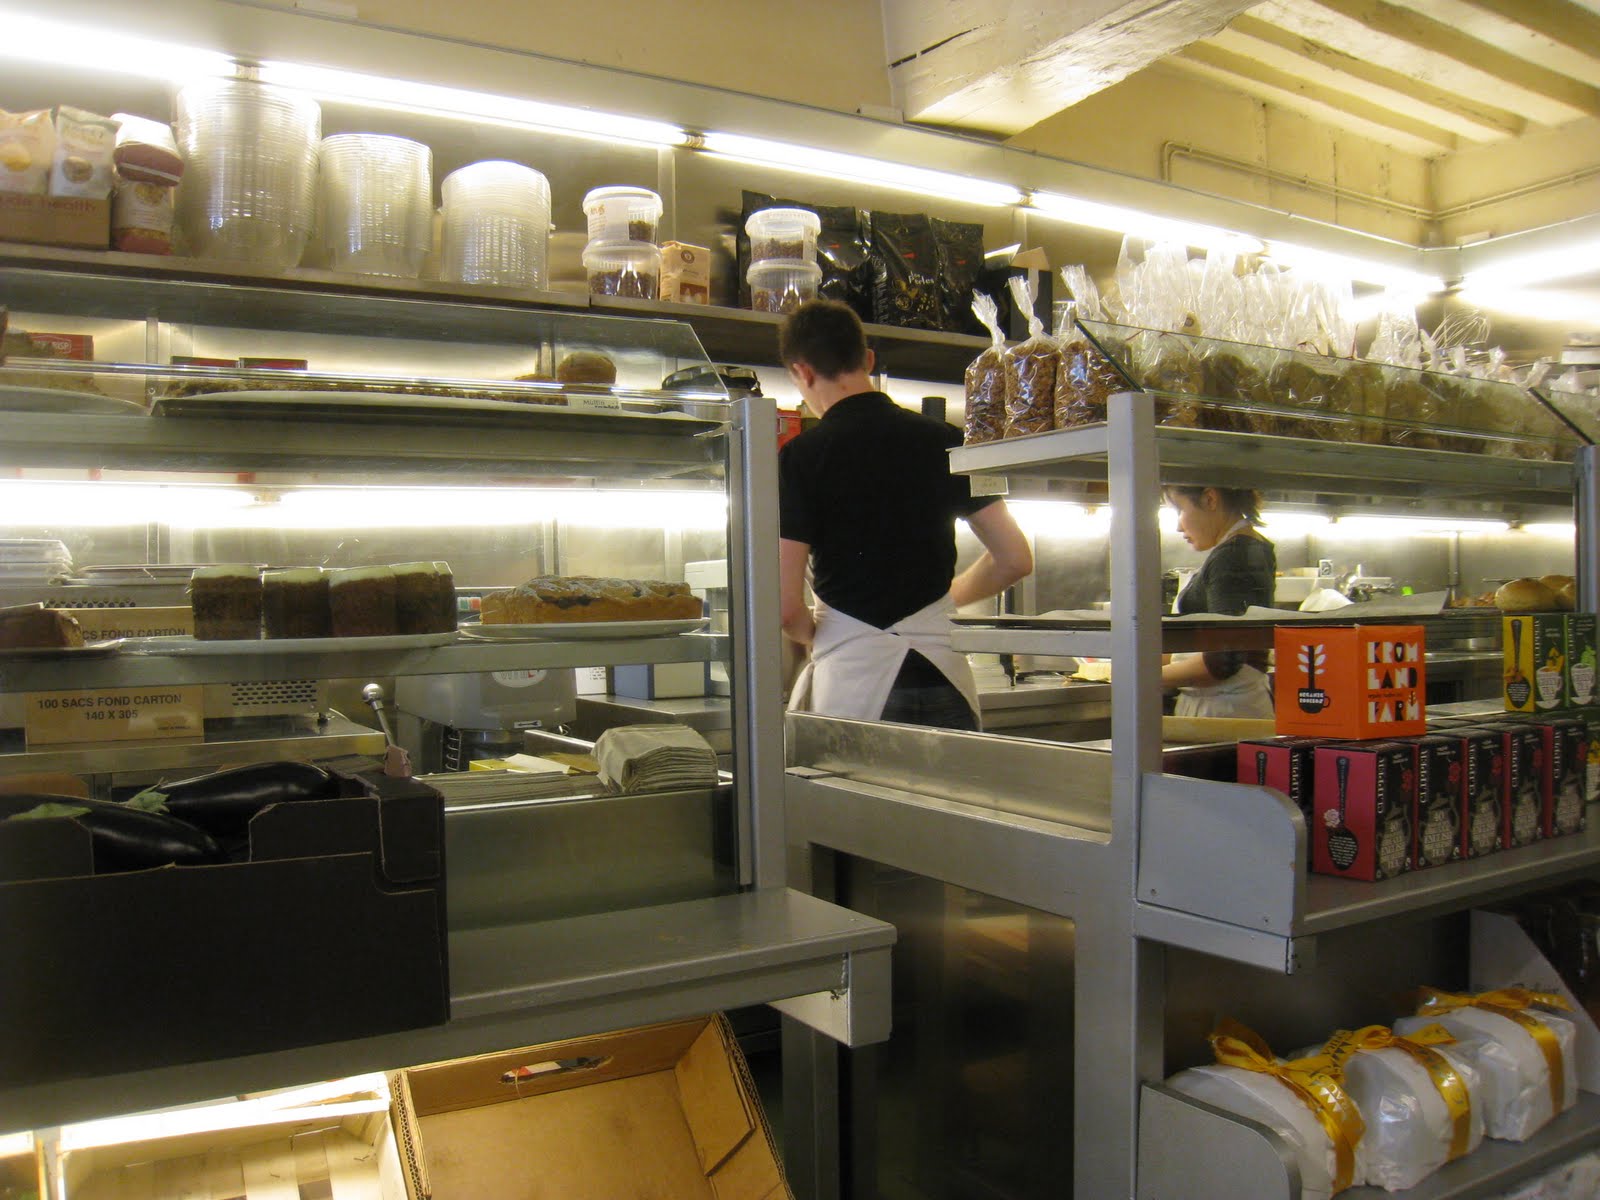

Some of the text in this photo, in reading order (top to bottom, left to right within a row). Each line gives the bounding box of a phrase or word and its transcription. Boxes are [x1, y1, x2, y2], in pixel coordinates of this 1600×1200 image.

[1367, 641, 1418, 663] KROM
[1367, 667, 1418, 689] LAND
[38, 694, 182, 709] 100 SACS FOND CARTON
[1367, 700, 1419, 723] FARM
[85, 709, 139, 721] 140 X 305
